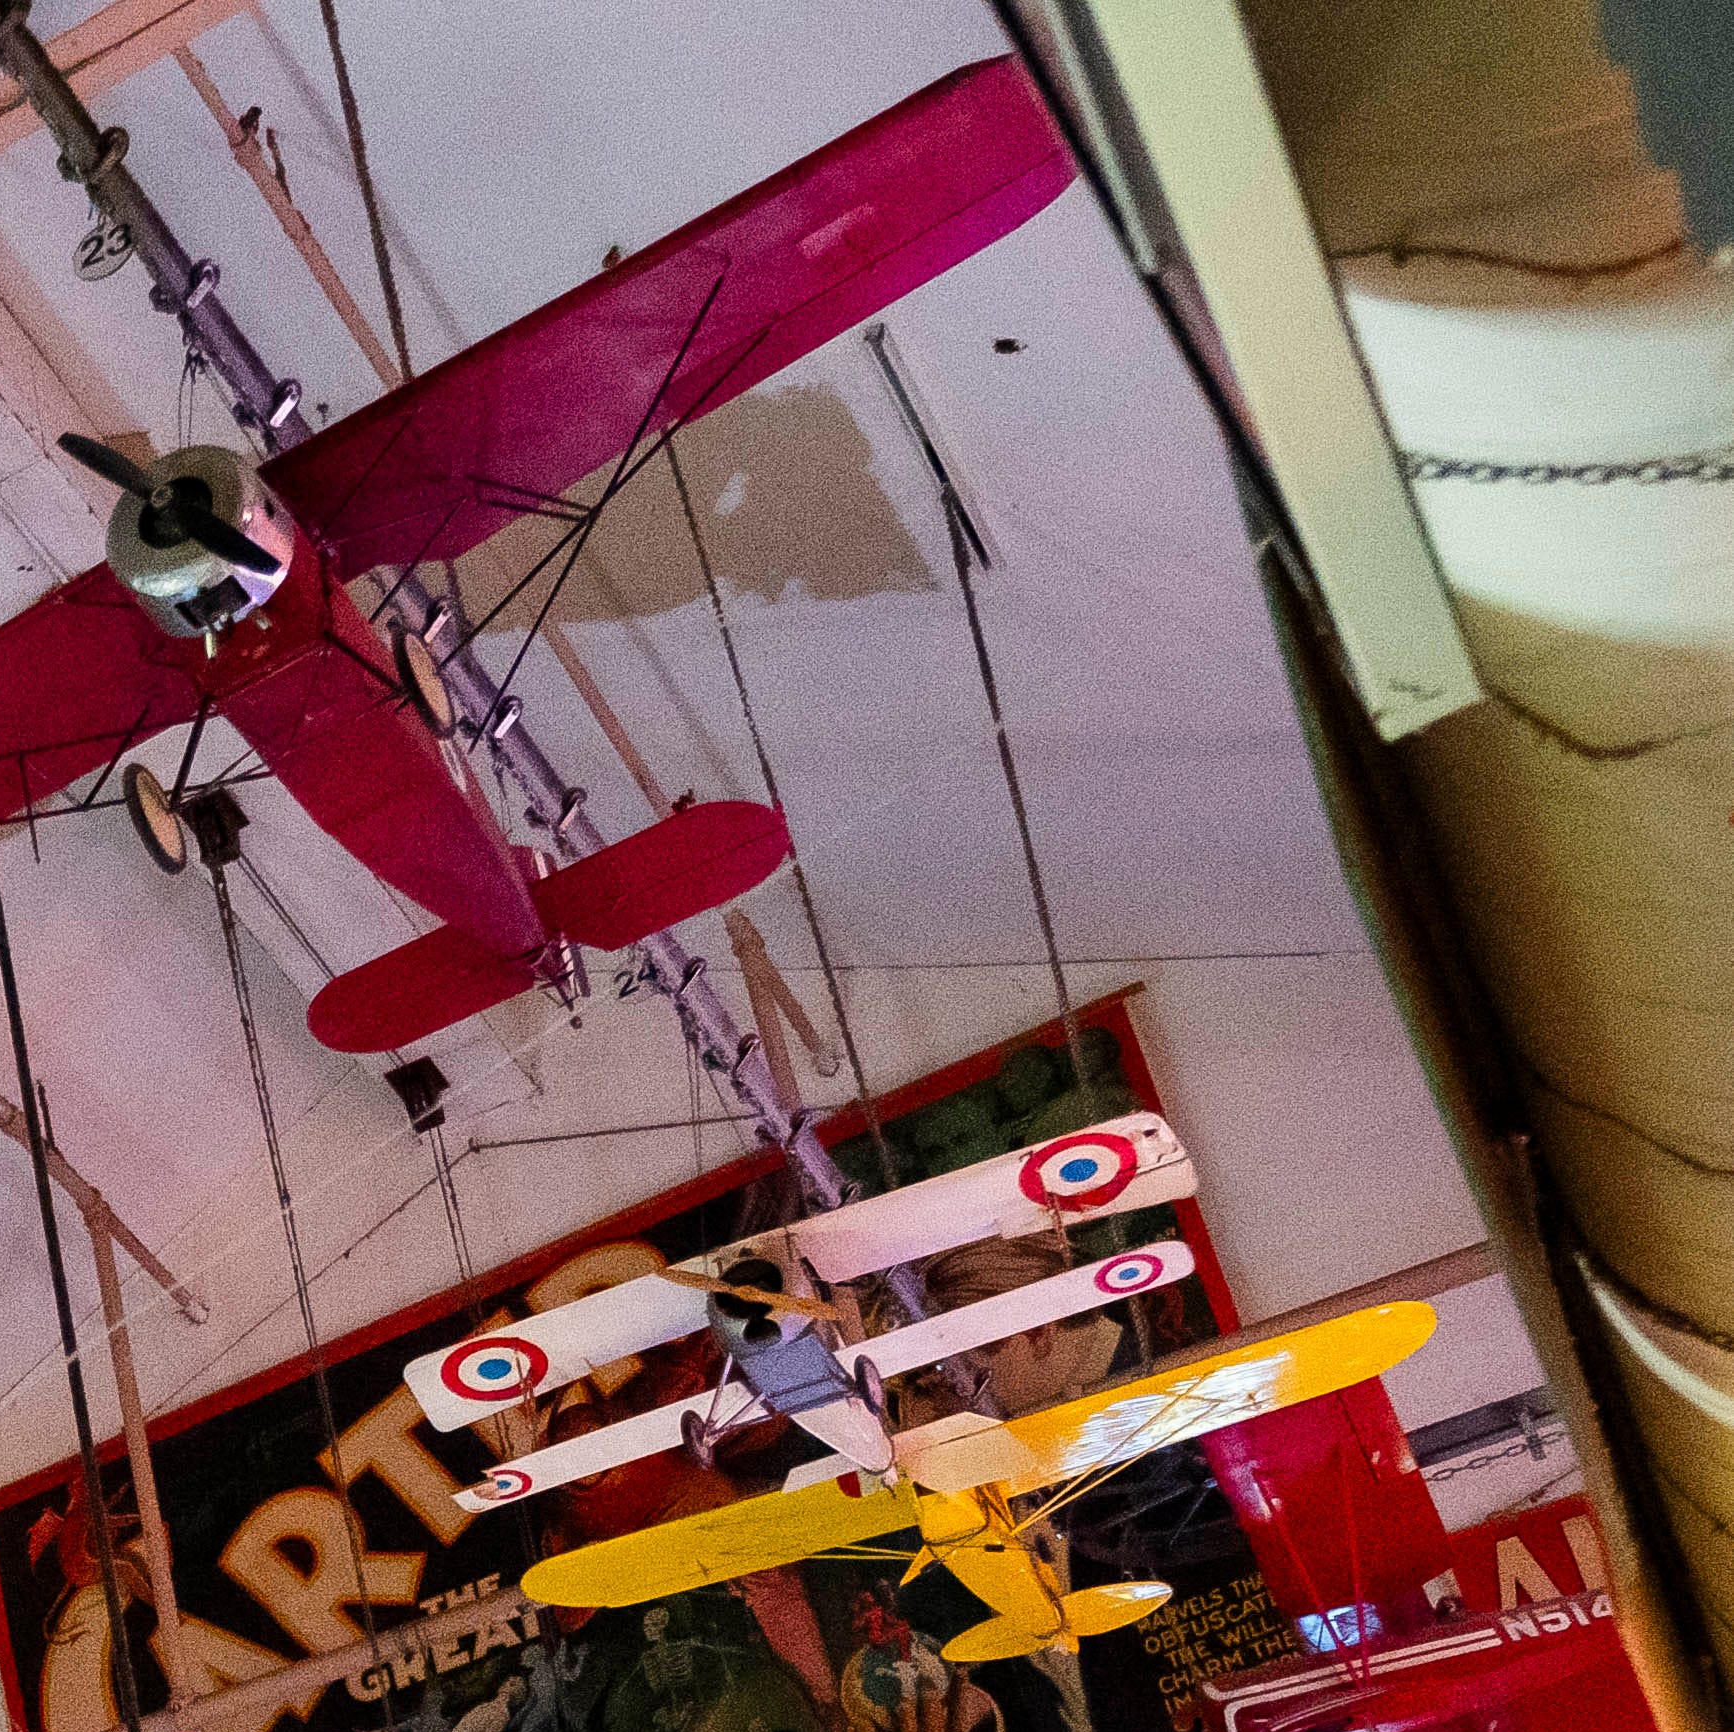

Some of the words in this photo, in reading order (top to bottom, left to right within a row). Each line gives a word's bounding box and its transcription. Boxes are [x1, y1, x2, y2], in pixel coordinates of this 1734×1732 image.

[1158, 1654, 1243, 1693] CHARM
[1252, 1628, 1297, 1659] THE
[1165, 1640, 1212, 1669] THE
